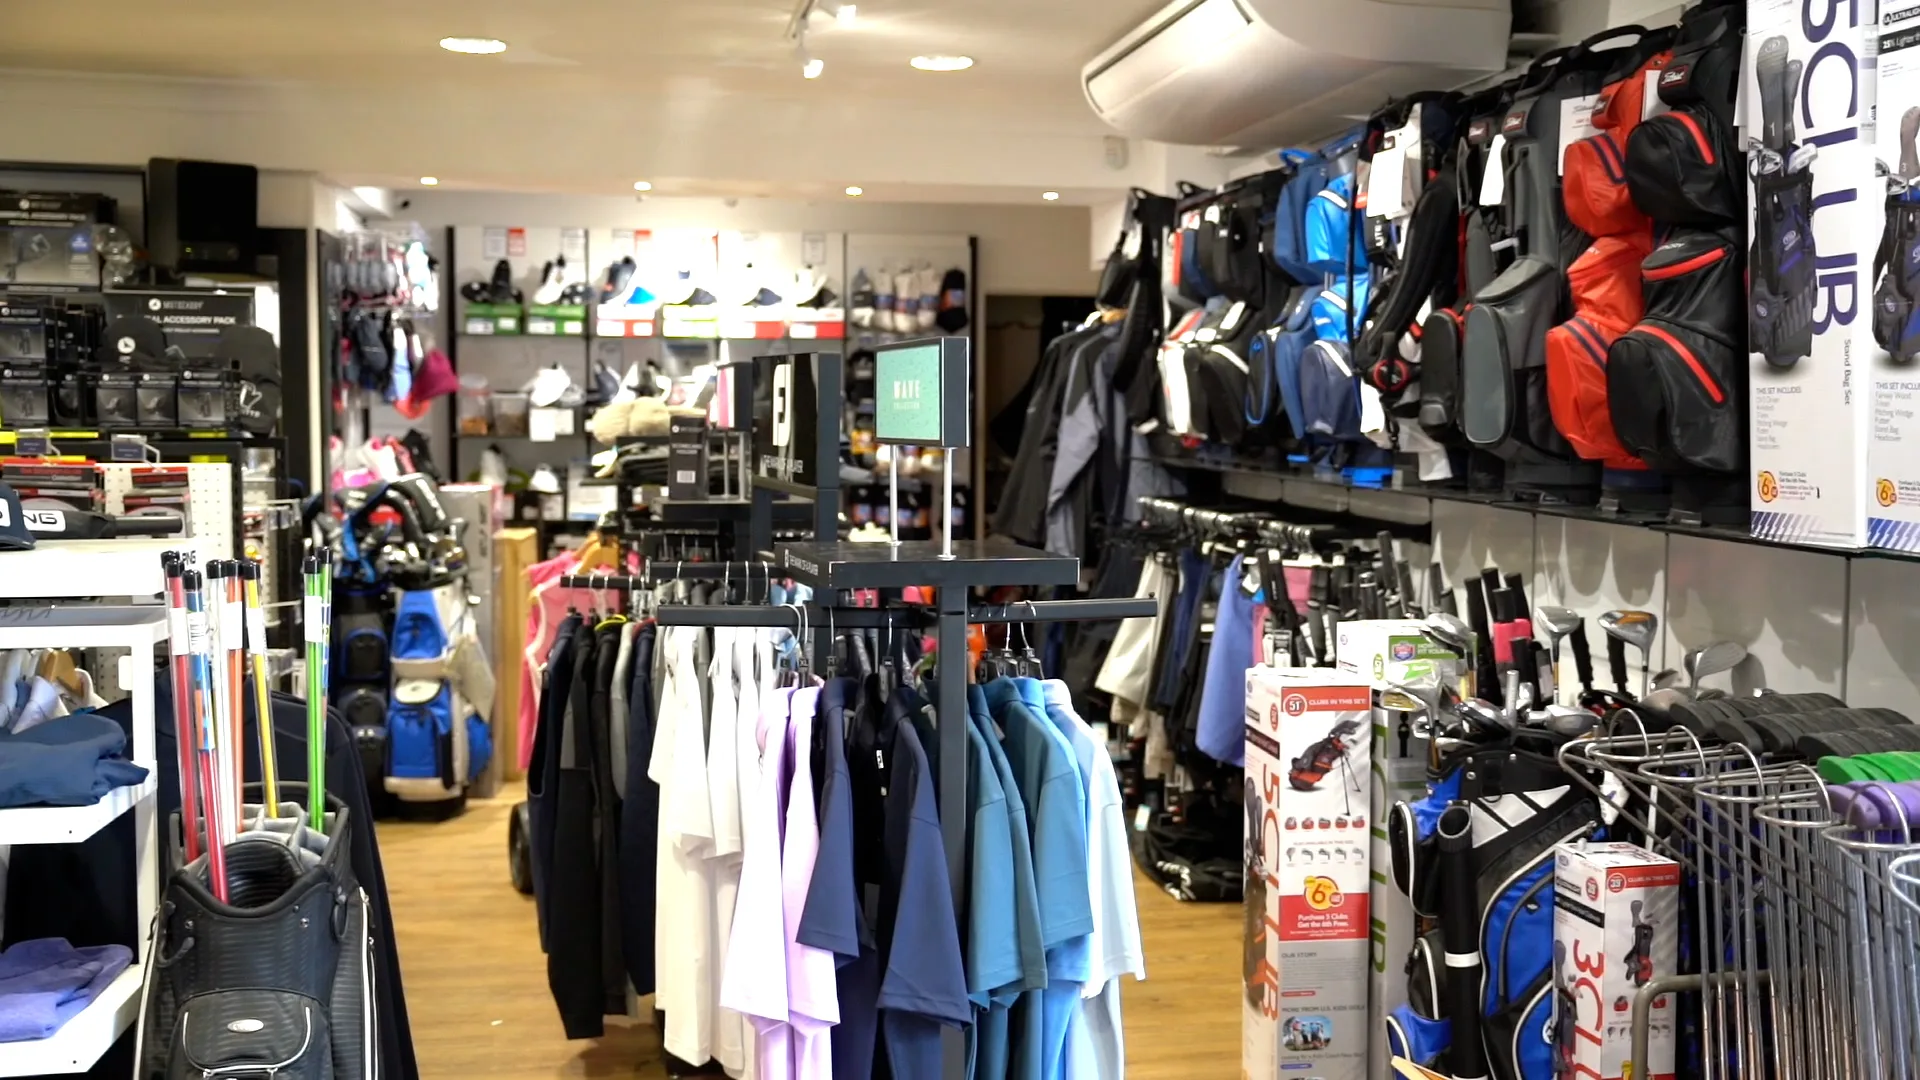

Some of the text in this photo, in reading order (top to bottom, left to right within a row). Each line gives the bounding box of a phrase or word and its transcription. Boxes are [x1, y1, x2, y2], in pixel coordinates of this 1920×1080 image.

[213, 316, 236, 325] PACK
[1844, 339, 1852, 367] Stand
[1843, 369, 1852, 388] Bag
[893, 380, 920, 399] WAVE
